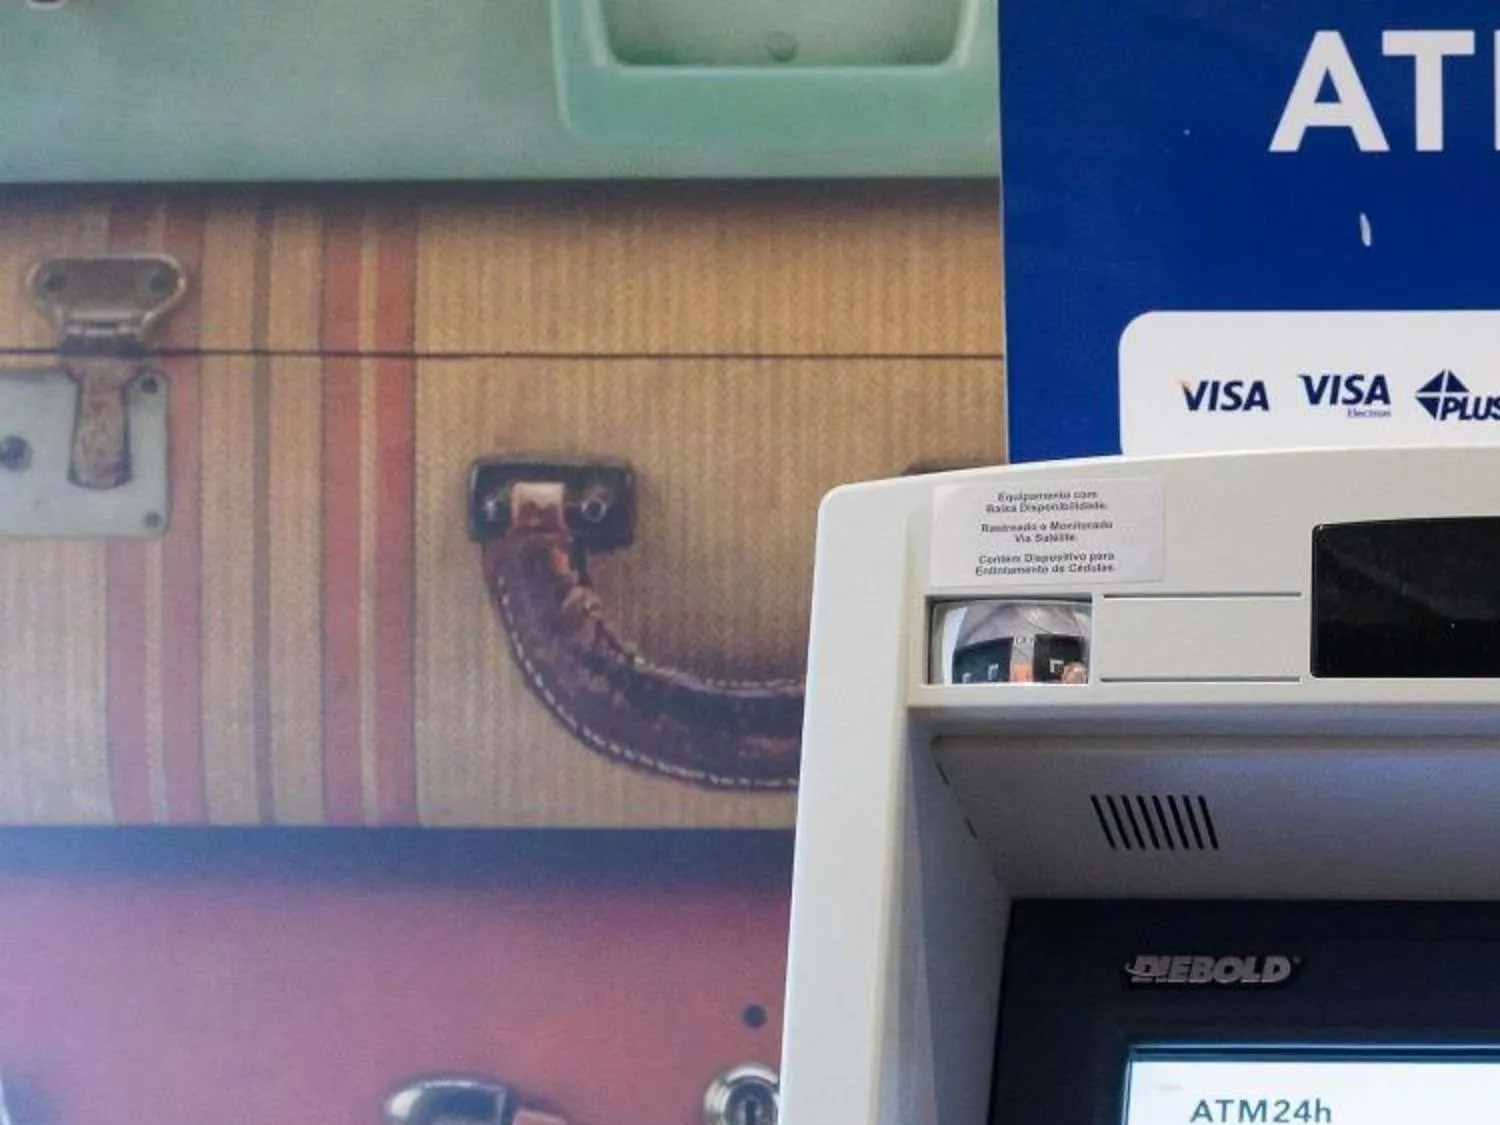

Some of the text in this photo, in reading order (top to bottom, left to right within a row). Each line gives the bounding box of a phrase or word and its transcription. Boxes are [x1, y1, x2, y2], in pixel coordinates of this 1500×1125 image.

[1179, 380, 1270, 412] VISA
[1298, 374, 1392, 406] VISA
[1347, 408, 1391, 418] Electron
[997, 491, 1098, 503] Equipamento com
[986, 504, 1017, 513] Baixa
[981, 523, 1037, 533] Rastreado
[1050, 520, 1113, 530] Monitorado
[1015, 534, 1031, 543] Via
[1024, 553, 1086, 565] Dispositivo
[1089, 552, 1115, 563] para
[1052, 564, 1065, 574] de
[1125, 954, 1292, 984] DIEBOLD
[1189, 1097, 1332, 1124] ATM24h
